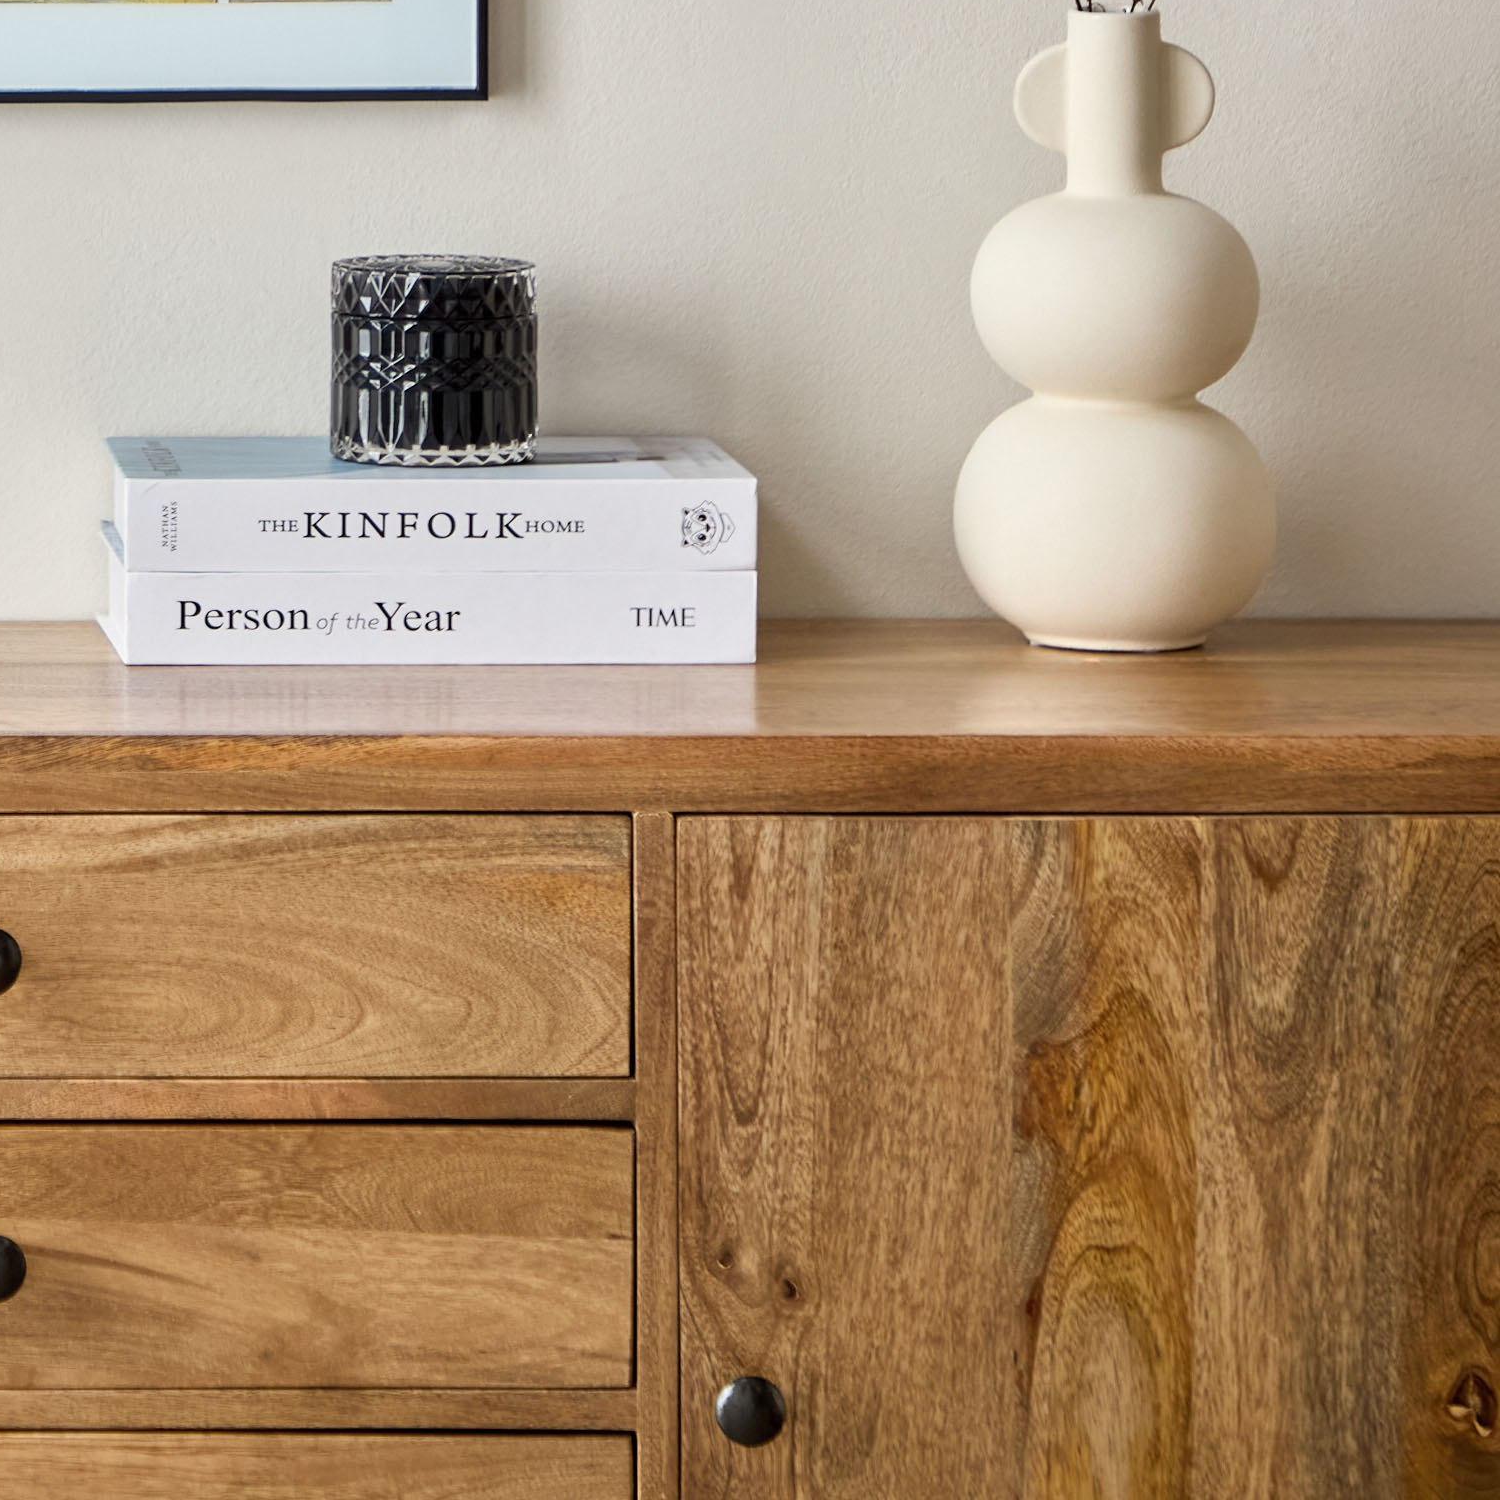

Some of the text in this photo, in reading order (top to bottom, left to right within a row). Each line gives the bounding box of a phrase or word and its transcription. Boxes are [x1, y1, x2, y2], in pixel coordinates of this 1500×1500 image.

[161, 505, 169, 547] NATHAN
[170, 501, 178, 552] WILLIAMS
[258, 512, 585, 539] THE KINFOLK HOME
[177, 600, 461, 635] Person of the Year
[630, 607, 696, 628] TIME
